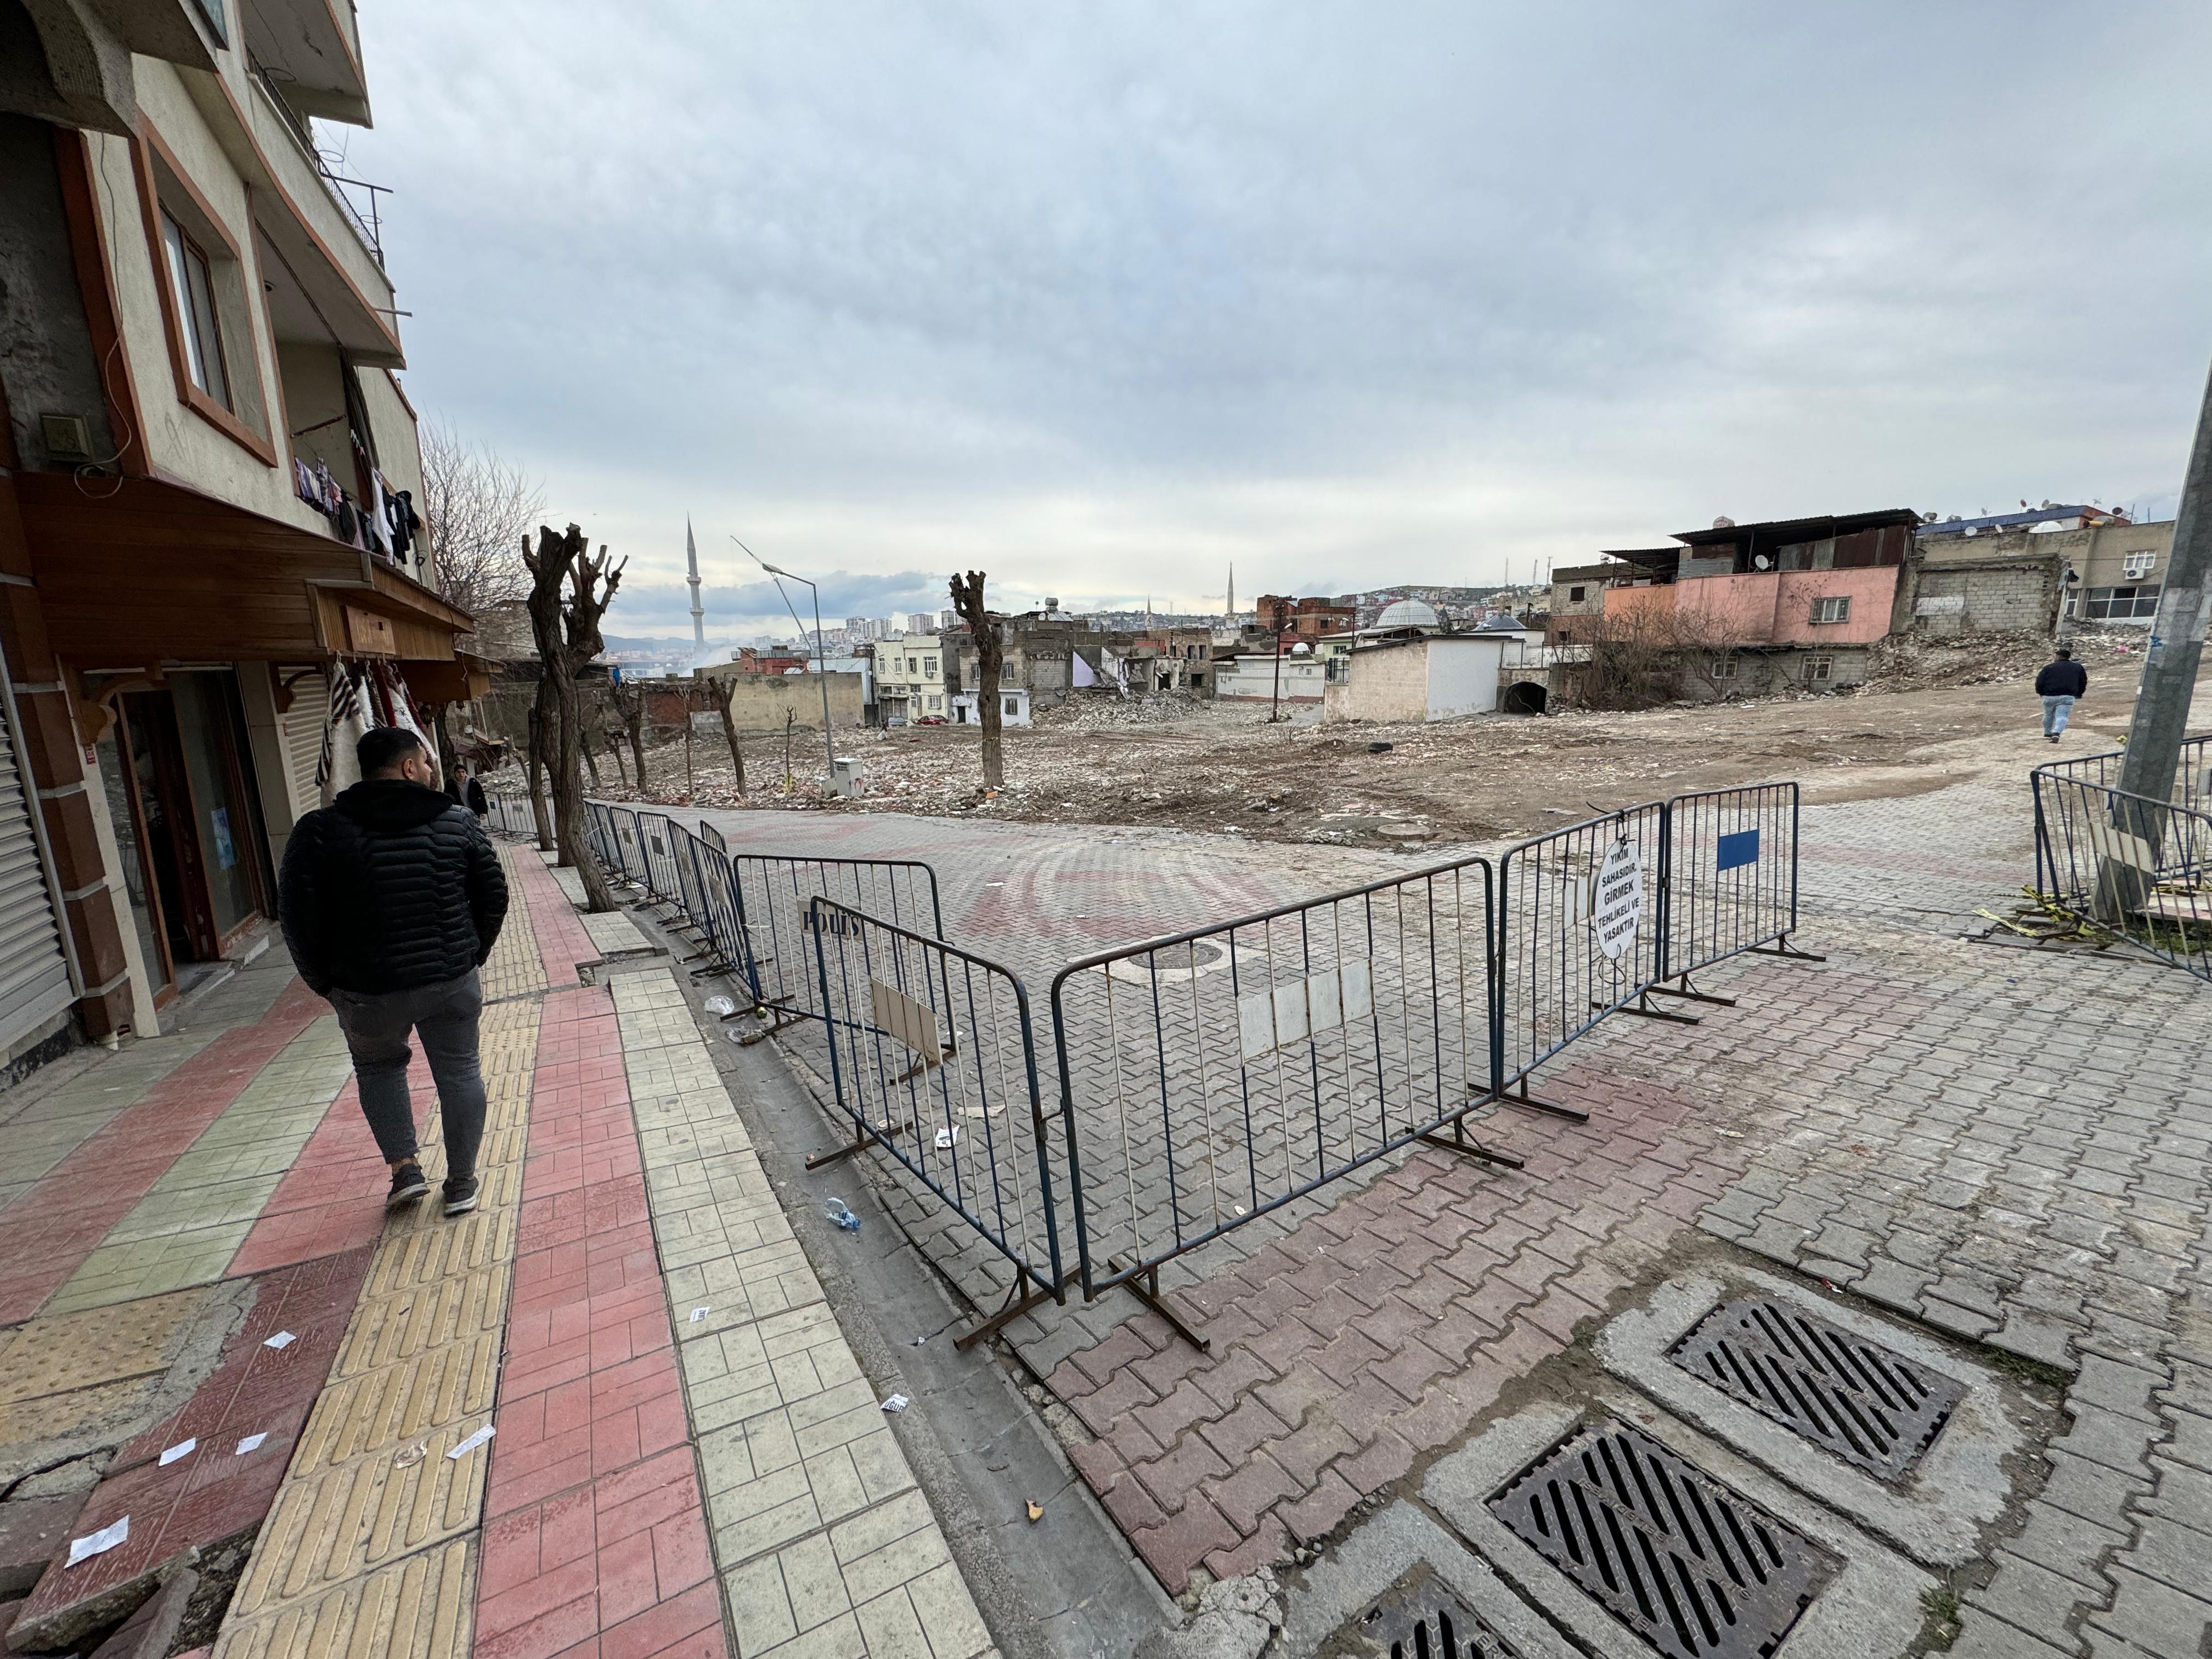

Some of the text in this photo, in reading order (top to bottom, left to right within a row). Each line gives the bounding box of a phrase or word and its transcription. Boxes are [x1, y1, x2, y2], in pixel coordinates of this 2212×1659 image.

[1611, 848, 1629, 865] YIKIM
[1602, 862, 1637, 888] SAHASIDIR.
[1604, 879, 1634, 905] GİRMEK
[1598, 897, 1639, 929] TEHLİKELİ VE
[1604, 917, 1634, 944] YASAKTIR
